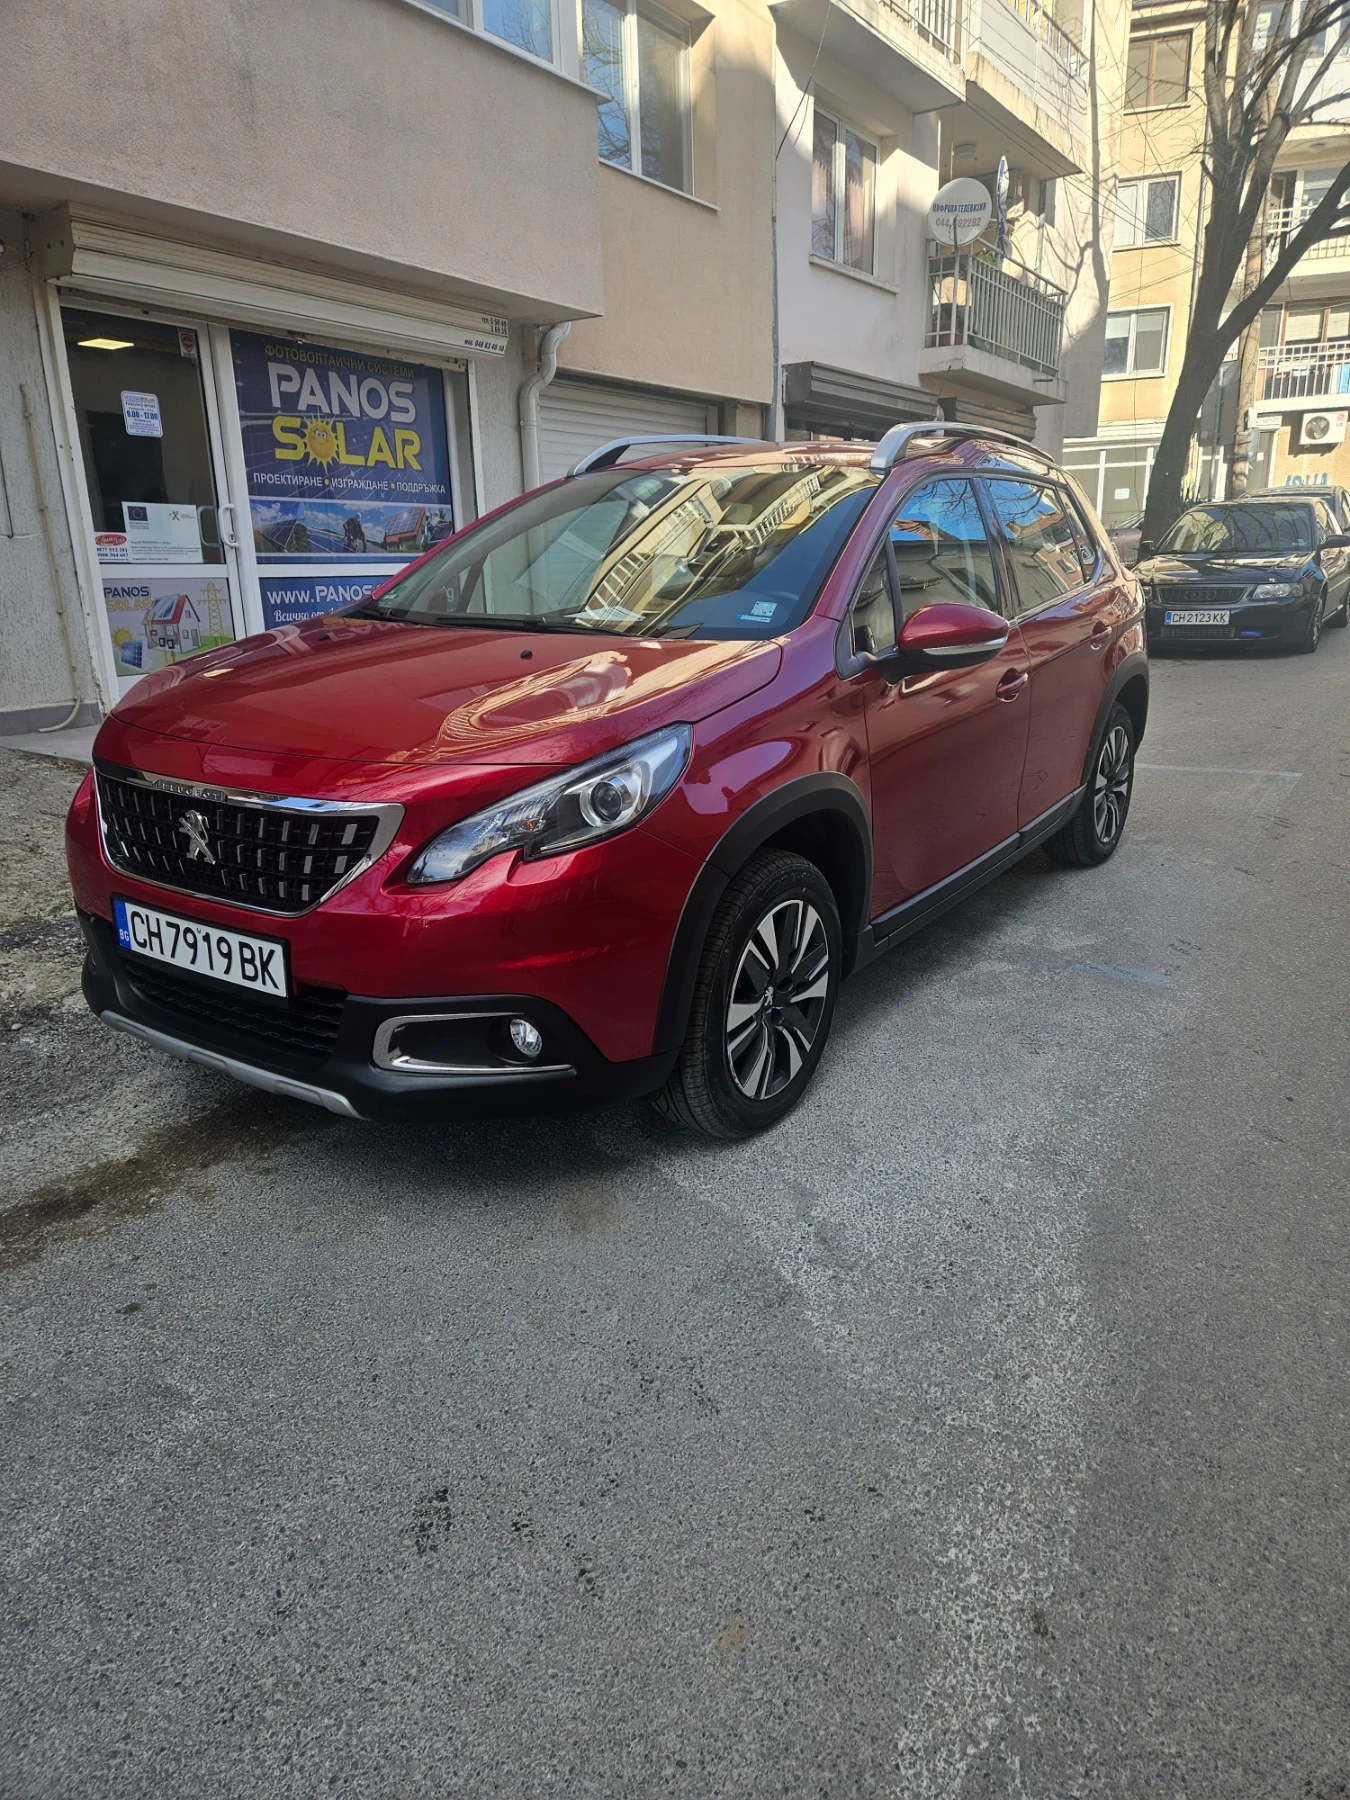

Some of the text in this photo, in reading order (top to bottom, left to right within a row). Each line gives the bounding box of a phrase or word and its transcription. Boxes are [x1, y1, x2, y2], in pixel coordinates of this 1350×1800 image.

[932, 202, 986, 213] ЦИФРОВА ТЕЛЕВИЗИЯ
[265, 344, 415, 378] ФОТОВОЛТАИЧНИ СИСТЕМИ
[267, 362, 416, 424] PANOS
[272, 414, 423, 472] SOLAR
[253, 472, 446, 494] ПРОЕКТИРАНЕ ИЗГРАЖДАНЕ ПОДДРЪЖКА
[104, 586, 150, 598] PANOS
[106, 598, 152, 612] SOLAR
[1172, 613, 1226, 623] CH2123KK
[119, 910, 279, 990] BG CH7919BK
